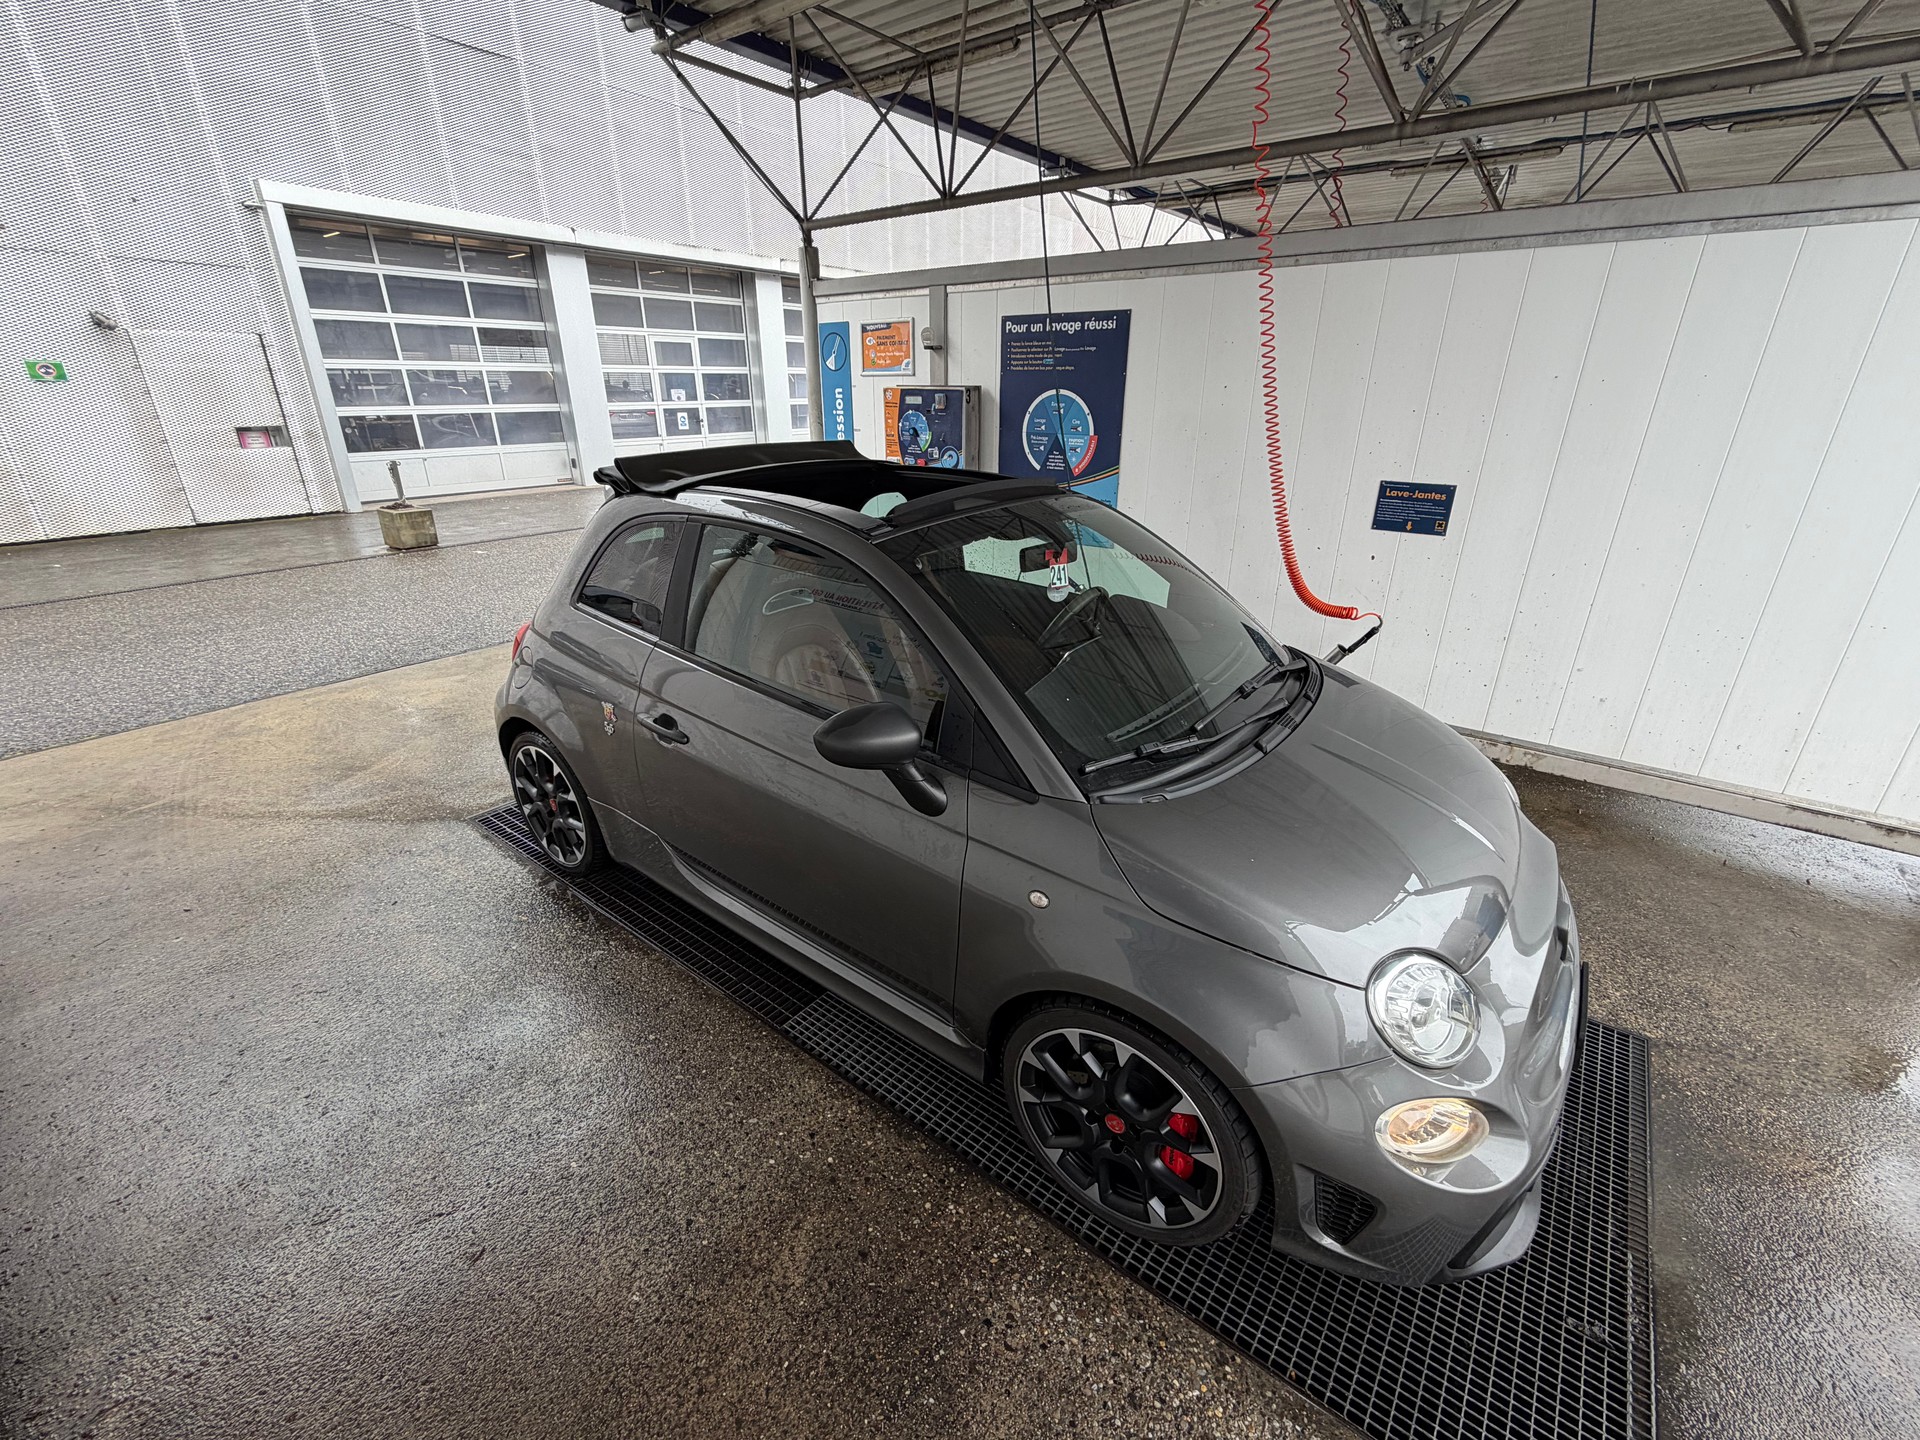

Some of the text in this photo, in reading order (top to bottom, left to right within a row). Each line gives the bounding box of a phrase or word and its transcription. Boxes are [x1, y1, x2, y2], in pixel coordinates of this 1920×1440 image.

[1006, 322, 1028, 333] Pour
[1031, 322, 1042, 332] un
[1085, 316, 1116, 330] réussi
[966, 389, 971, 404] 3
[1386, 488, 1446, 500] Lave-Jantes
[1051, 565, 1067, 585] 241
